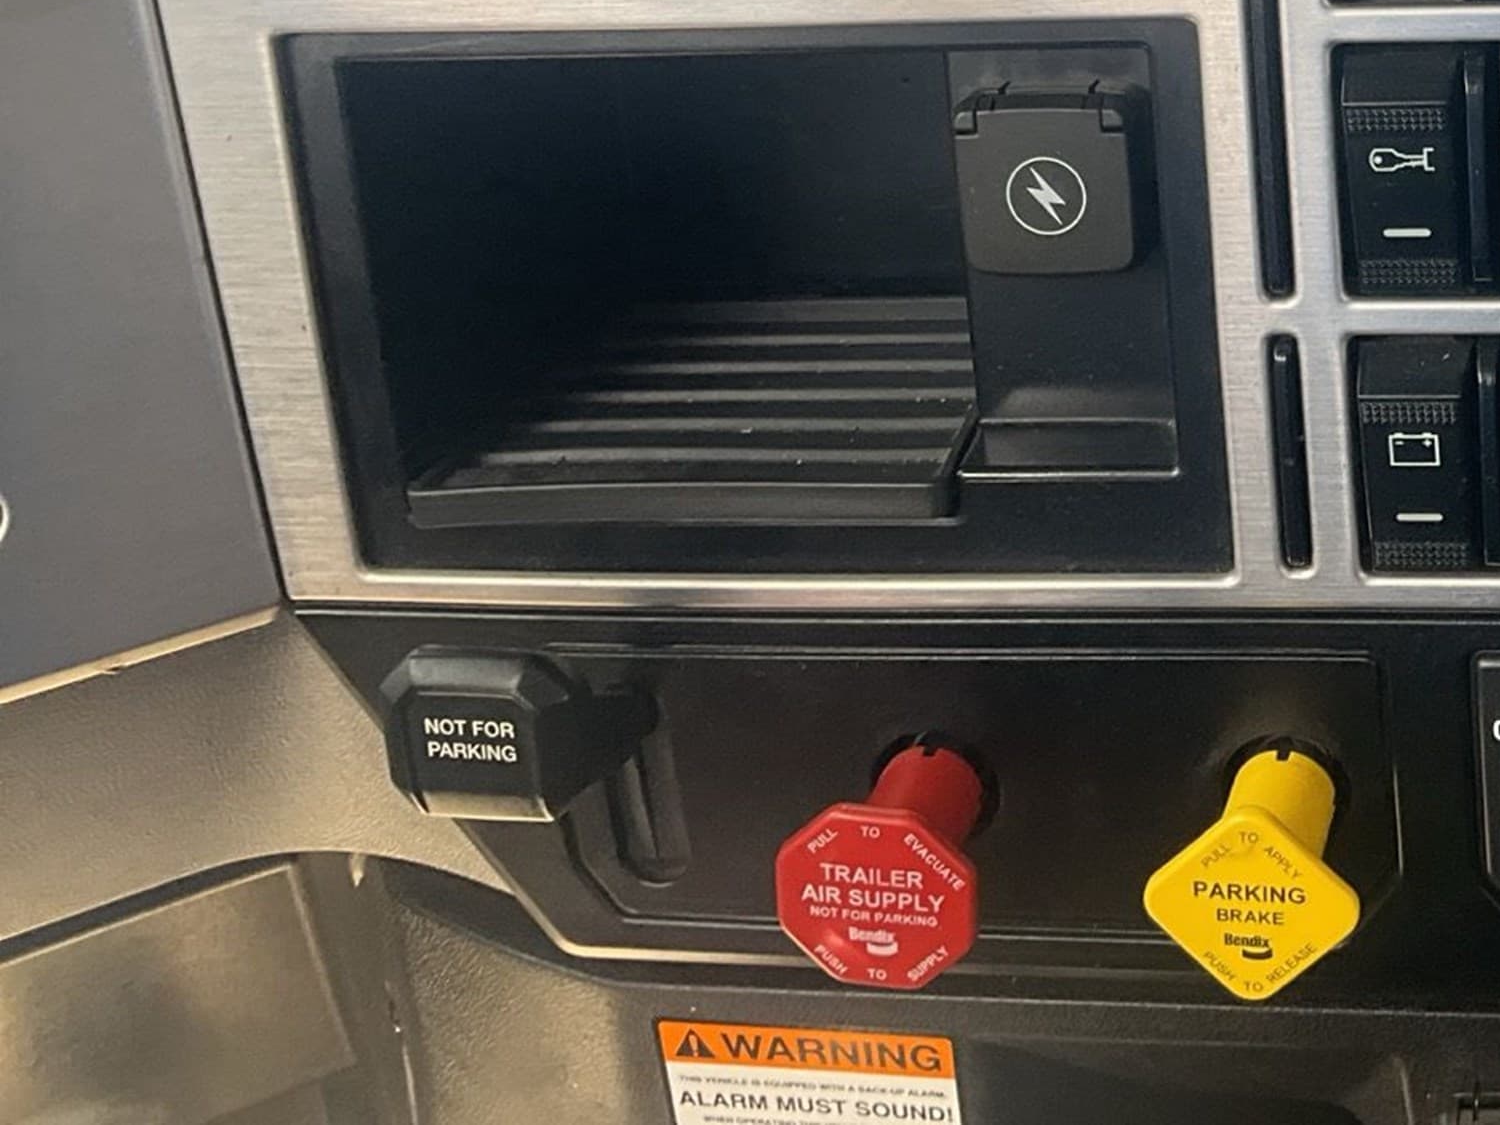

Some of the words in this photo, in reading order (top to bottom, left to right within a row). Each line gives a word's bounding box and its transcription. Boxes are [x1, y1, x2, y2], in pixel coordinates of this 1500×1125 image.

[424, 717, 466, 736] NOT
[472, 720, 515, 739] FOR
[427, 741, 517, 762] PARKING
[807, 828, 838, 854] PULL
[860, 826, 880, 839] TO
[903, 833, 966, 891] EVACUATE
[1200, 844, 1231, 869] PULL
[1239, 831, 1259, 844] TO
[1264, 846, 1303, 880] APPLY
[820, 862, 923, 889] TRAILER
[801, 884, 841, 905] AIR
[849, 888, 945, 913] SUPPLY
[1193, 881, 1306, 905] PARKING
[809, 905, 838, 918] NOT
[842, 909, 870, 923] FOR
[874, 911, 938, 928] PARKING
[1216, 907, 1285, 926] BRAKE
[848, 926, 896, 943] Bendix
[1224, 932, 1270, 949] Bendix
[813, 944, 847, 975] PUSH
[867, 968, 887, 980] TO
[908, 945, 949, 982] SUPPLY
[1204, 951, 1236, 982] PUSH
[1243, 980, 1264, 993] TO
[1266, 943, 1318, 984] RELEASE
[720, 1032, 942, 1072] WARNING
[680, 1090, 769, 1111] ALARM
[776, 1095, 846, 1115] MUST
[855, 1100, 953, 1123] SOUND!
